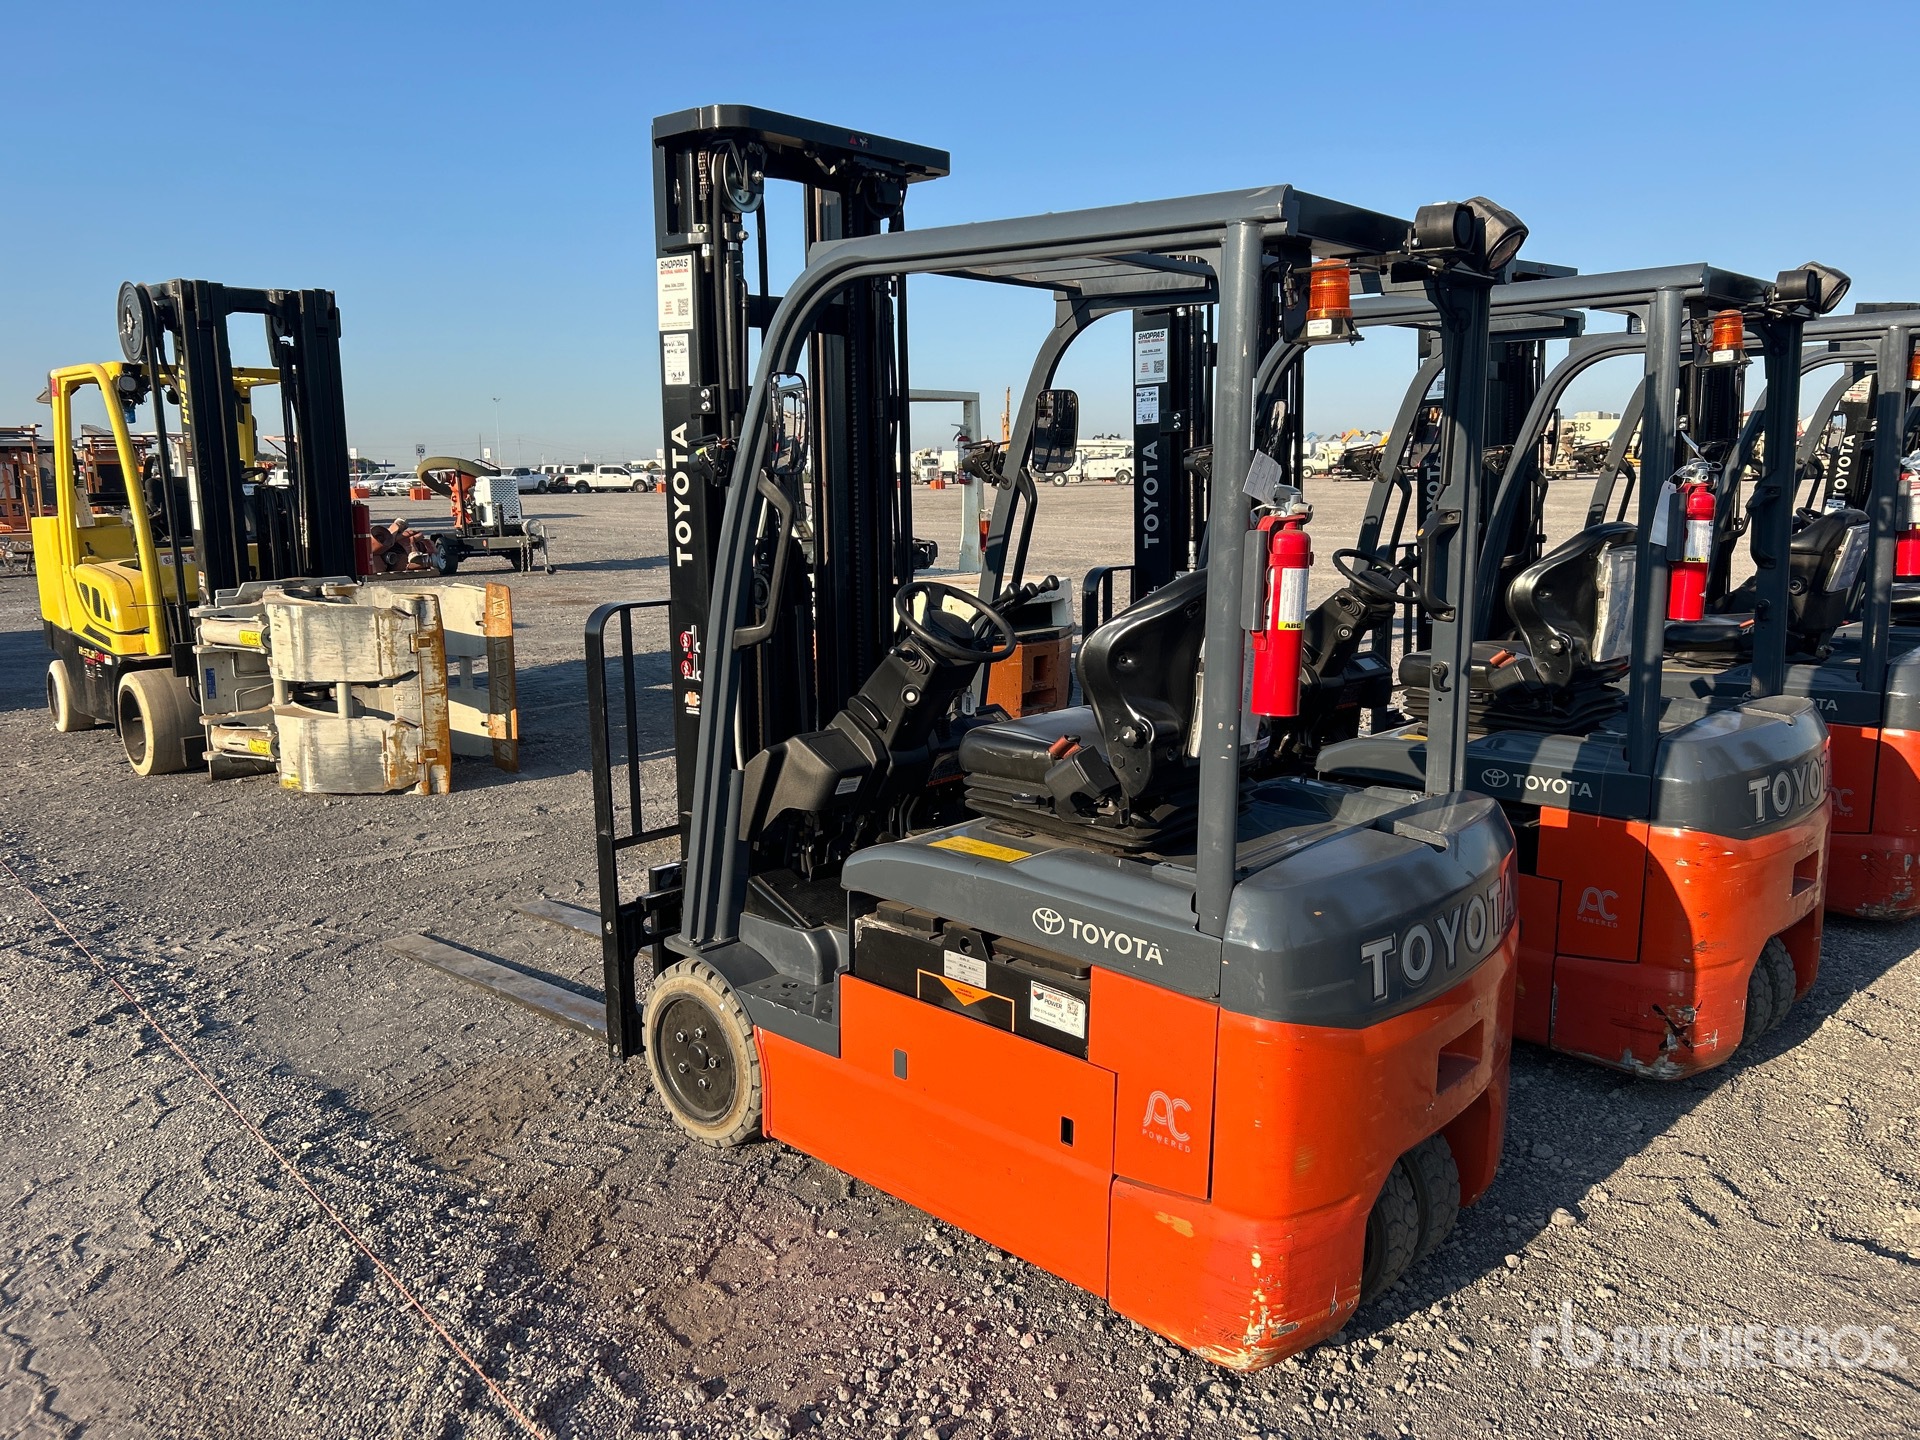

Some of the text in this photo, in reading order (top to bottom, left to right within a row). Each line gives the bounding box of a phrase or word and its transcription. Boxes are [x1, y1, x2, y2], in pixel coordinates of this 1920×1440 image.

[1832, 434, 1856, 498] TOYOTA
[671, 422, 693, 567] TOYOTA
[1142, 440, 1160, 549] TOYOTA
[1512, 774, 1593, 798] TOYOTA
[1748, 752, 1830, 823] TOYOT
[1576, 915, 1618, 929] POWERED
[1577, 886, 1619, 921] AC
[1068, 917, 1164, 966] TOYOTA
[1361, 868, 1516, 1003] TOYOTA
[1142, 1090, 1192, 1142] AC
[1142, 1128, 1191, 1153] POWERED
